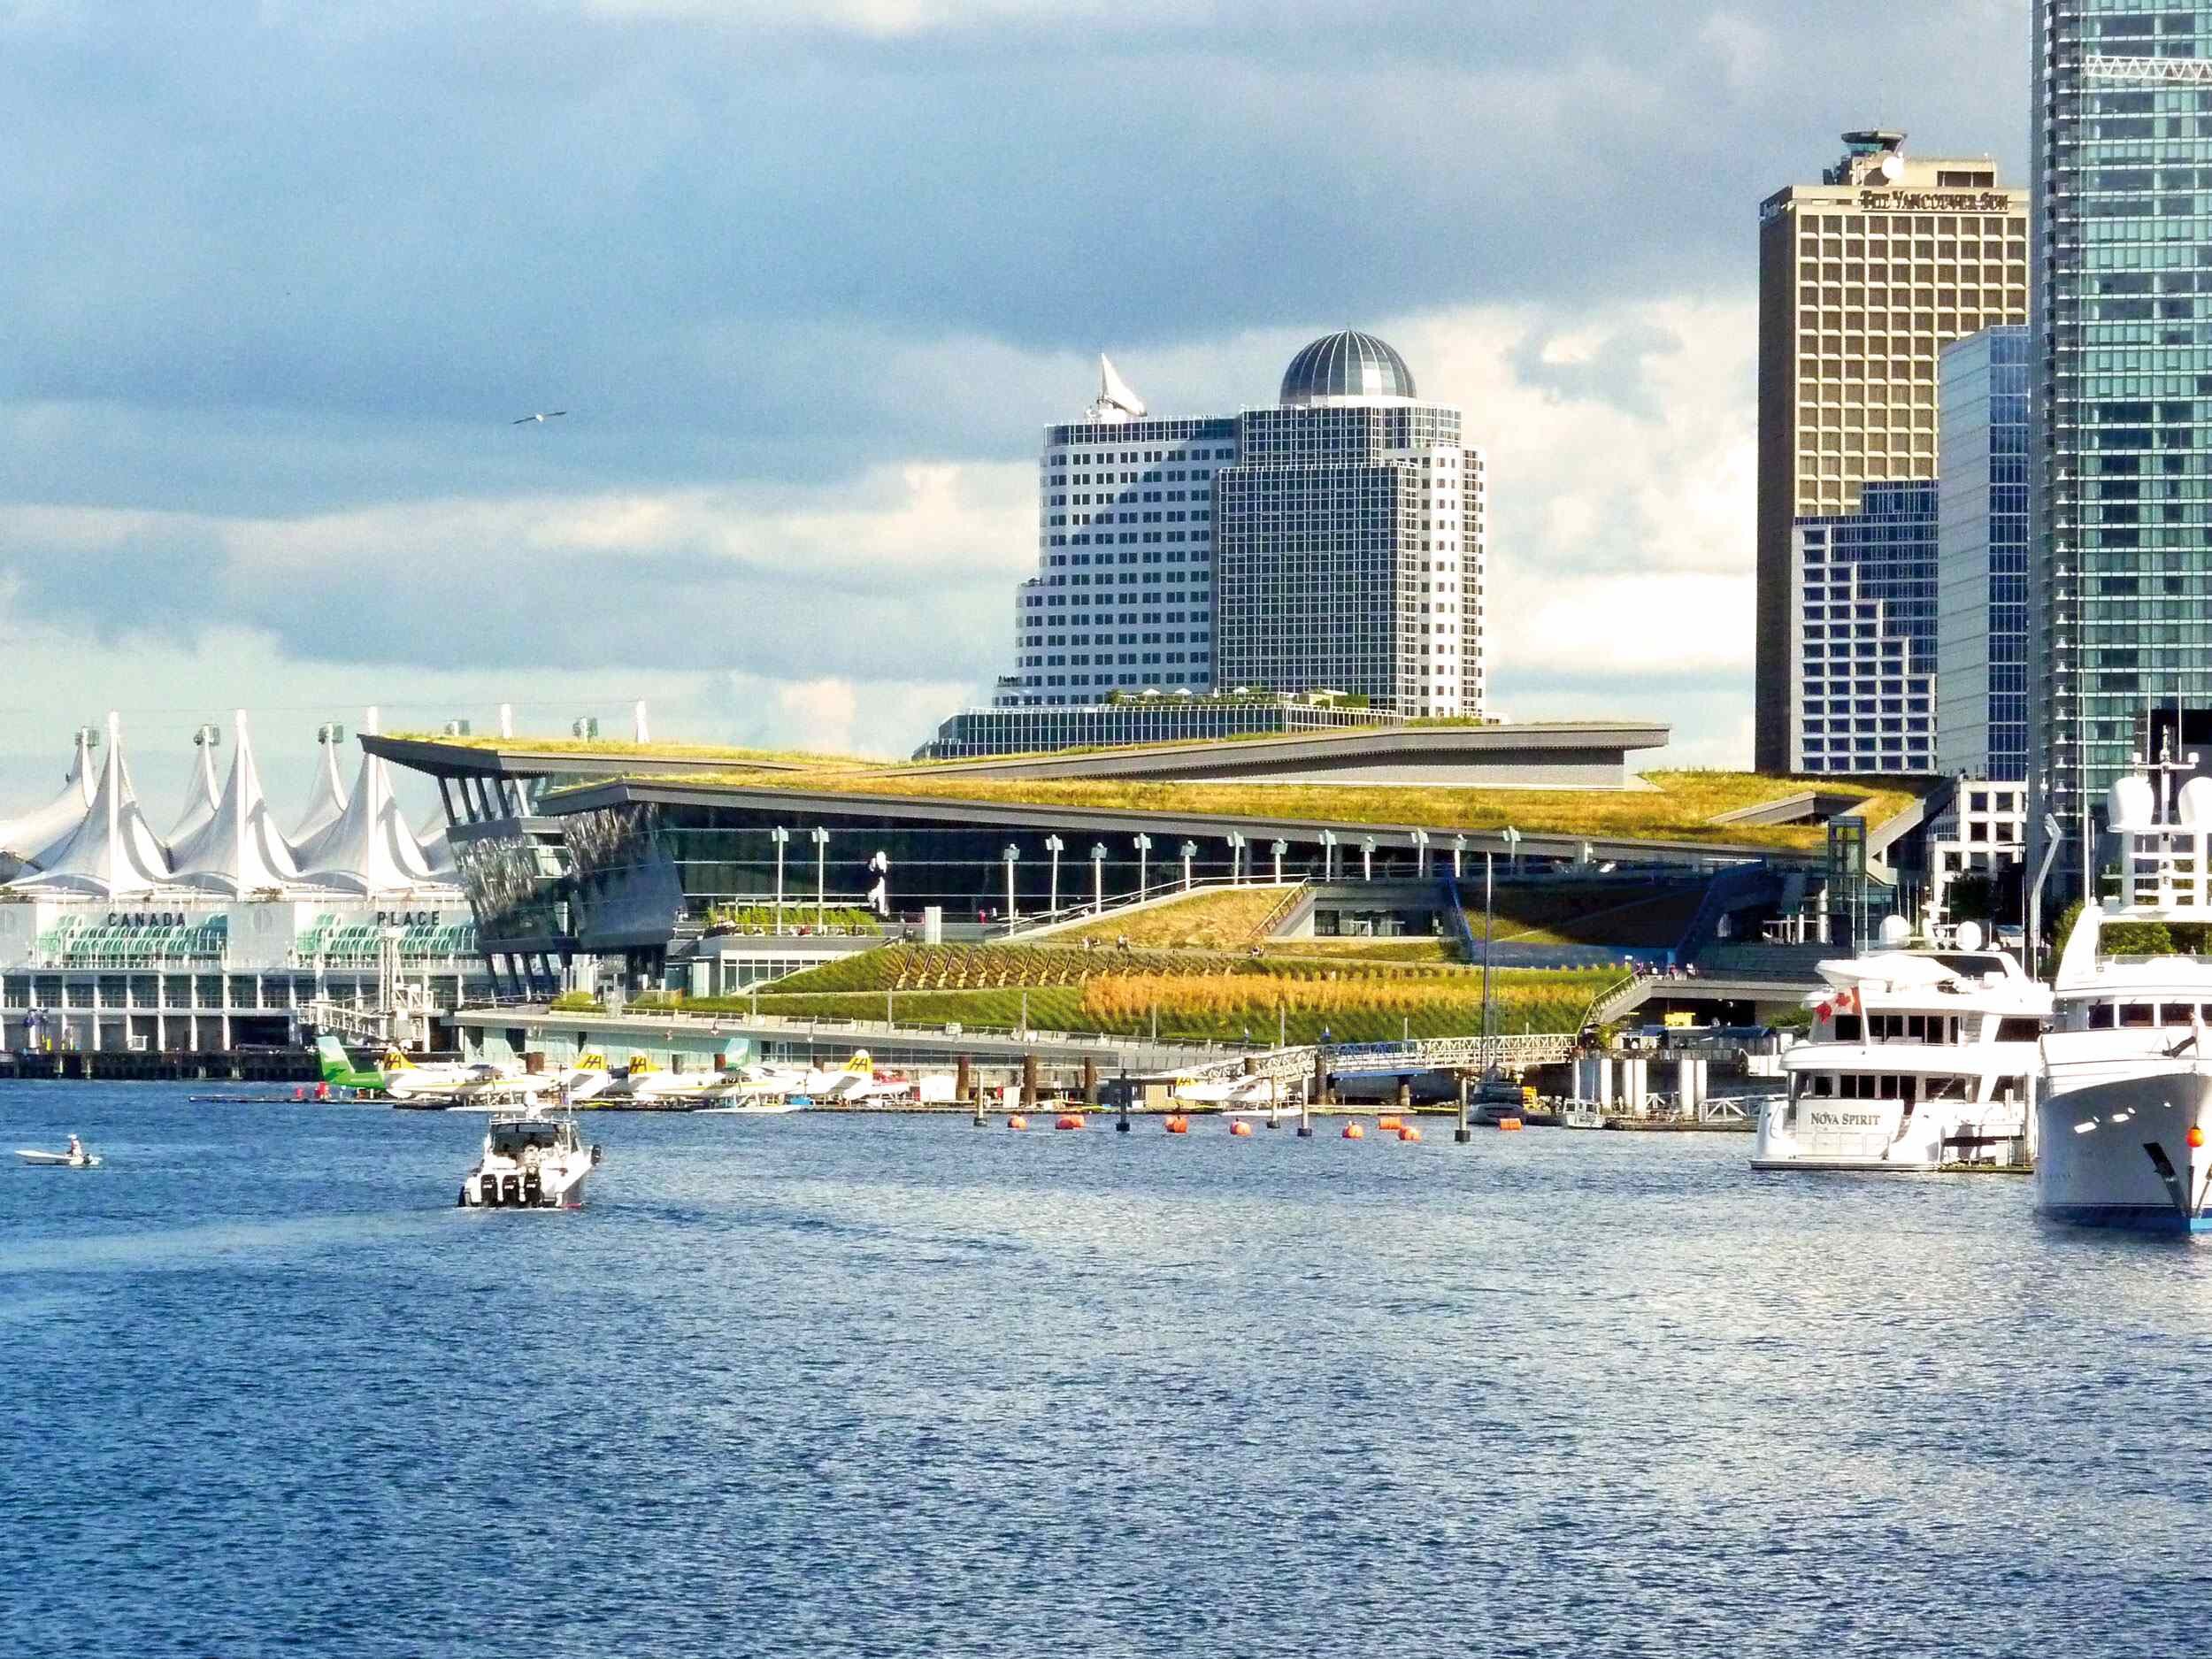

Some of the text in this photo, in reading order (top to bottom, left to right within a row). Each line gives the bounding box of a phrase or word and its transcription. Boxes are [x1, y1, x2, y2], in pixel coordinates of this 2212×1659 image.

[108, 912, 186, 926] CANADA
[377, 910, 440, 926] PLACE
[1810, 1111, 1881, 1125] NOVA SPIRIT
